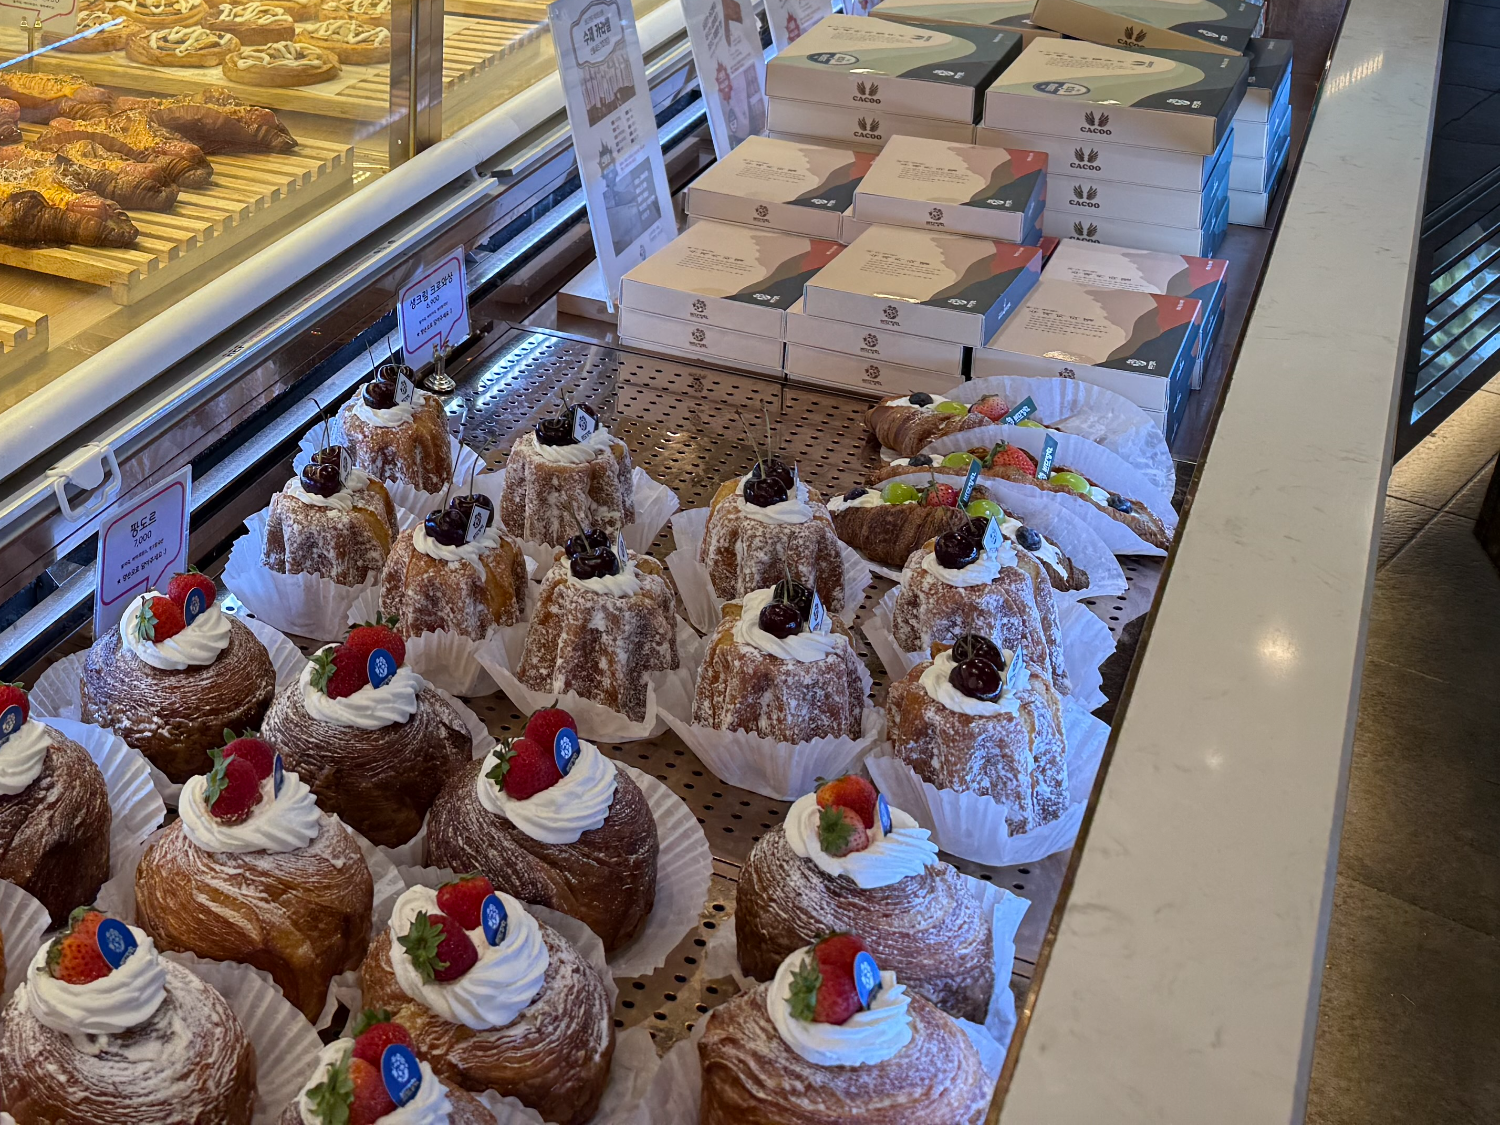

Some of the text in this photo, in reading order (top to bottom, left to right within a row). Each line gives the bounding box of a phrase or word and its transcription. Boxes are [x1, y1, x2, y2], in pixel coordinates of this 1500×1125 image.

[852, 95, 882, 105] CACOO
[853, 131, 882, 141] CACOO
[1080, 126, 1112, 136] CACOO
[1069, 162, 1102, 172] CACOO
[1068, 199, 1100, 209] CACOO
[430, 271, 453, 296] 크로와상
[130, 510, 157, 538] 팡도르
[133, 530, 152, 548] 7,000
